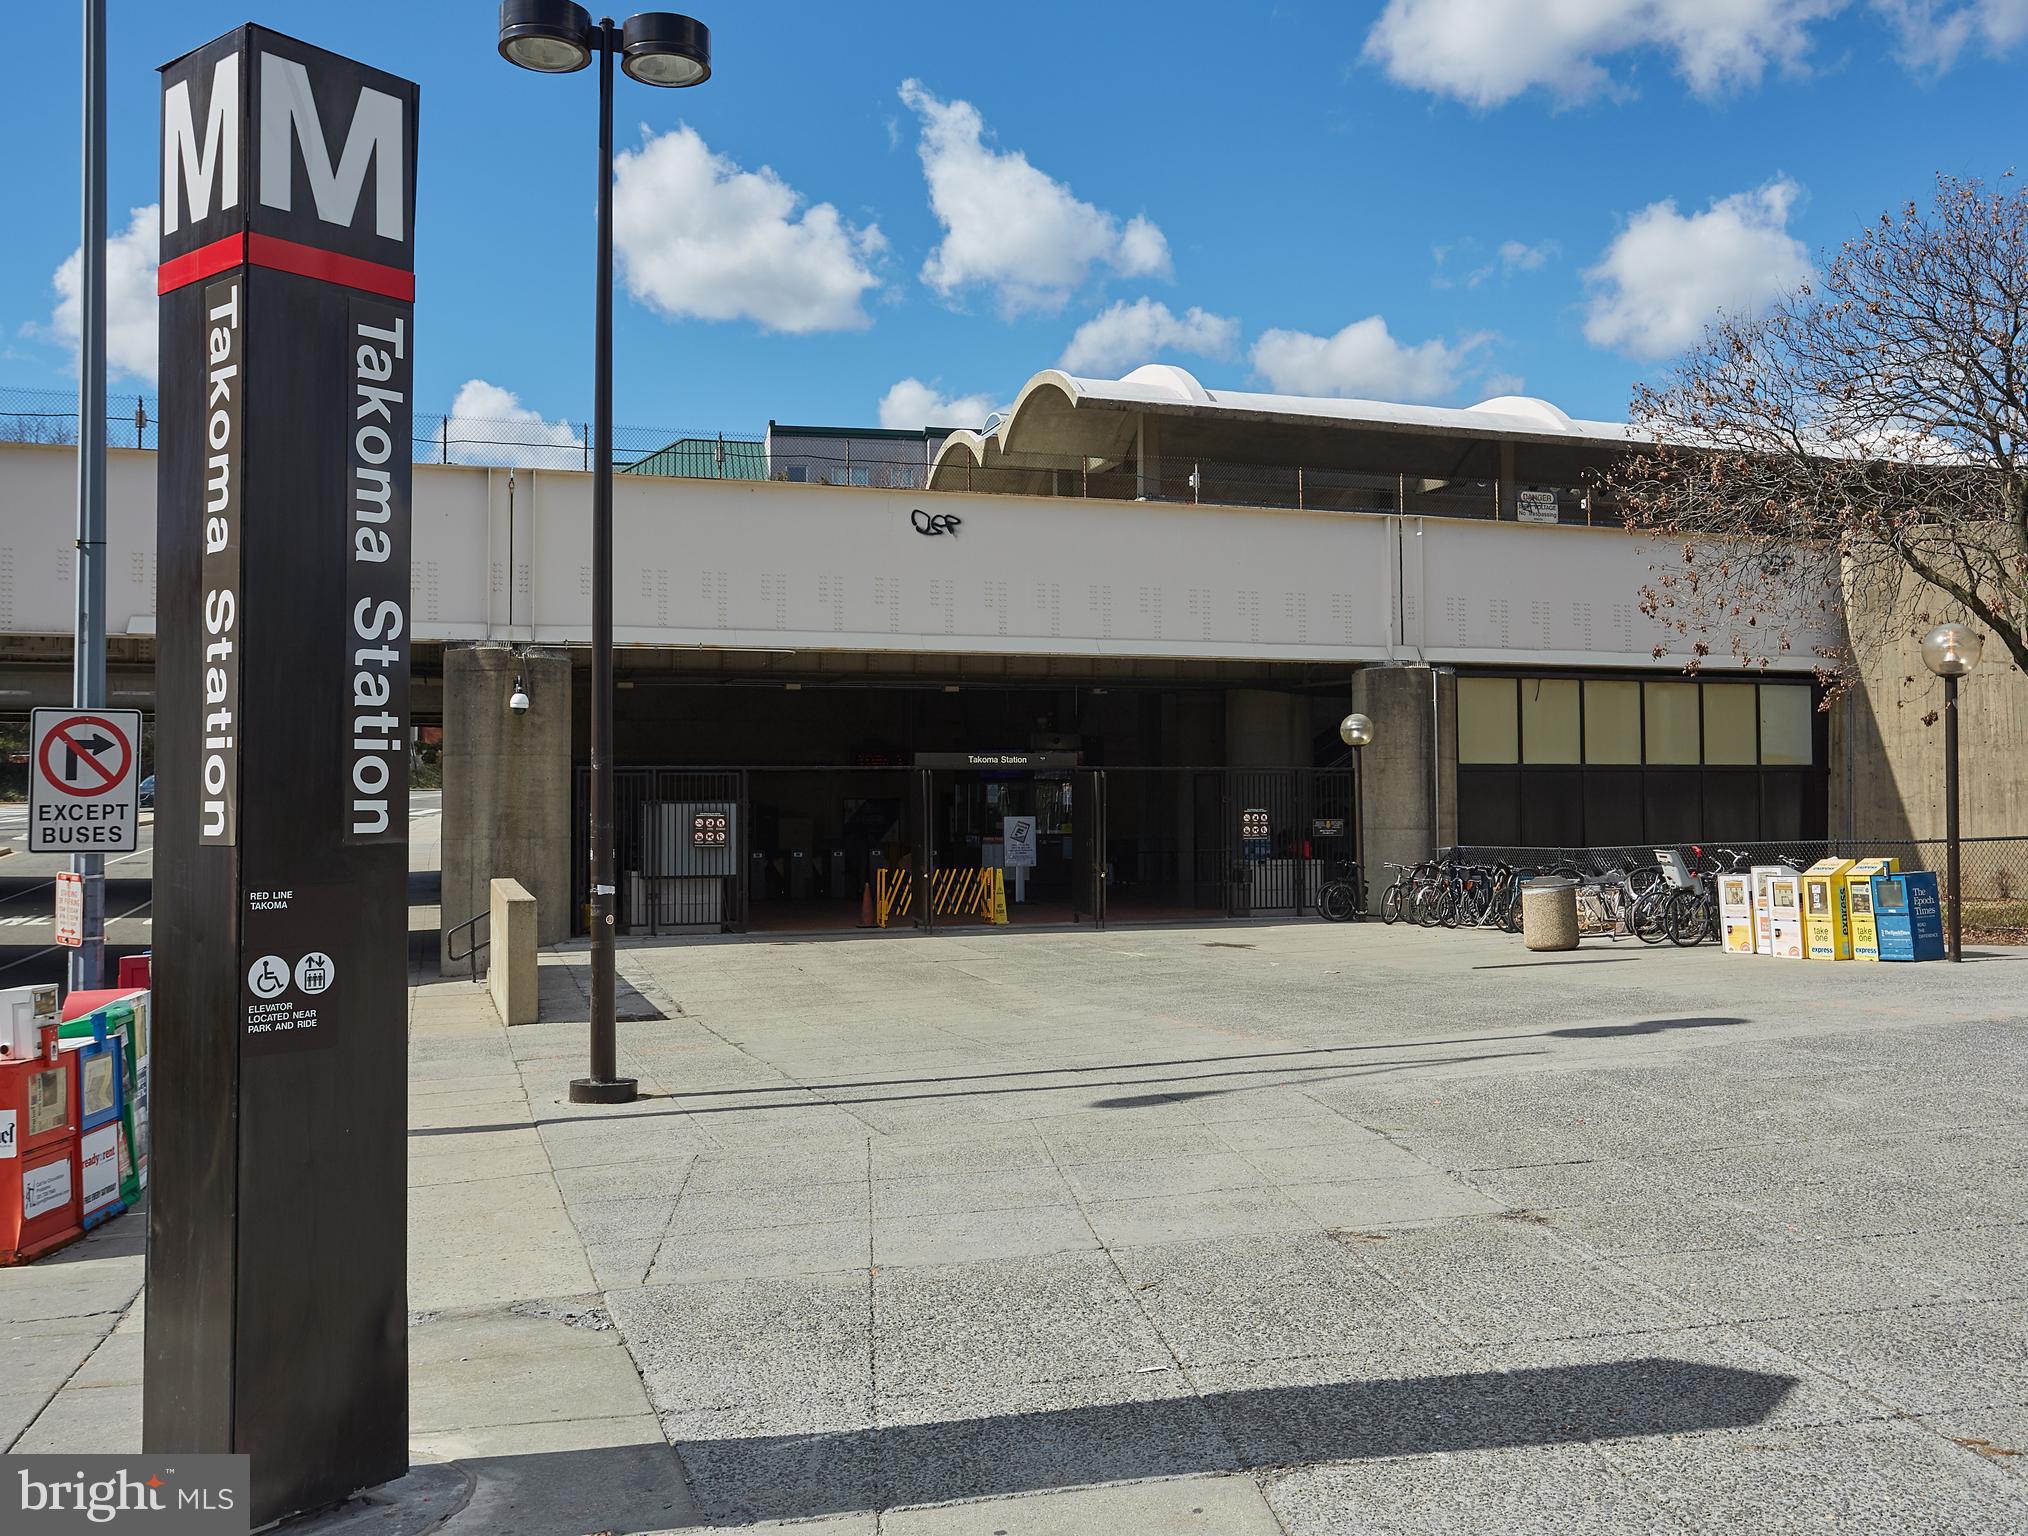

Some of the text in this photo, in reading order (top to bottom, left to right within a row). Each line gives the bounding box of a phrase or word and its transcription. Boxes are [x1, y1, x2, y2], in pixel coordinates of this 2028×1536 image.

[164, 51, 239, 236] M
[260, 51, 404, 242] M
[203, 284, 237, 836] Takoma Station
[352, 317, 404, 834] Takoma Station
[968, 755, 1027, 764] Takoma Station
[39, 804, 128, 821] EXCEPT
[42, 826, 122, 843] BUSES
[250, 890, 293, 900] RED LINE
[1912, 887, 1926, 896] The
[250, 901, 288, 910] TAKOMA
[1913, 895, 1935, 906] Epoch
[1914, 906, 1936, 915] Times
[1813, 926, 1829, 935] take
[1857, 926, 1872, 935] take
[248, 1002, 293, 1013] ELEVATOR
[248, 1010, 317, 1023] LOCATED NEAR
[248, 1019, 317, 1033] PARK AND RIDE
